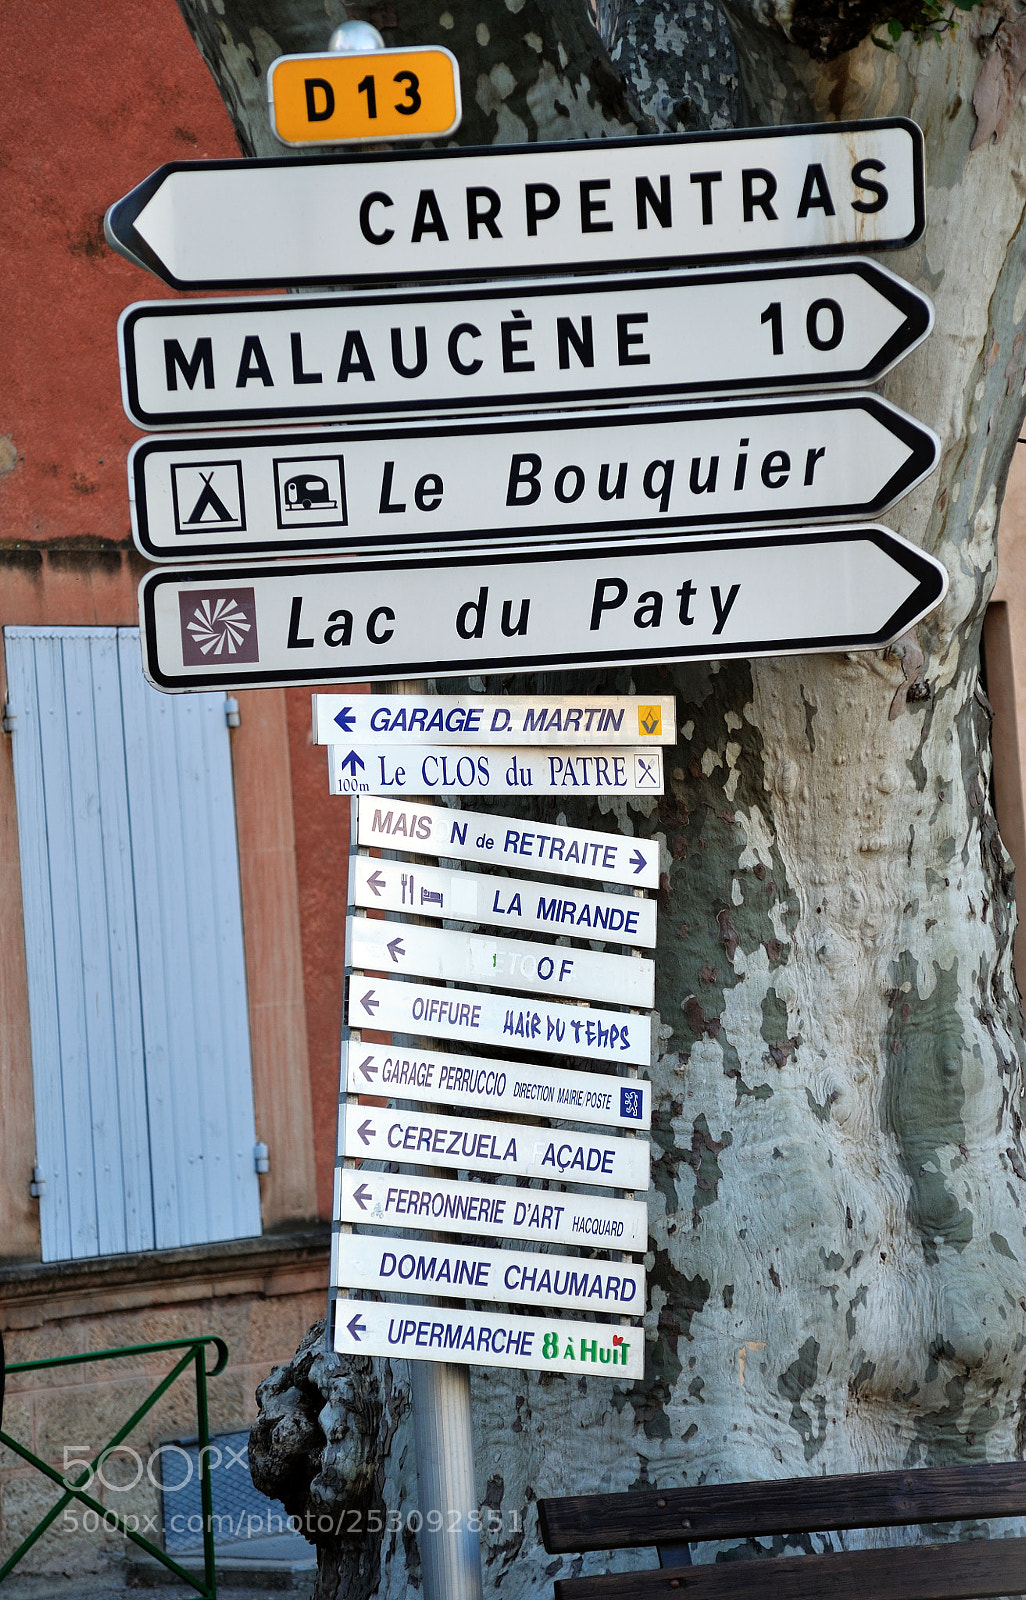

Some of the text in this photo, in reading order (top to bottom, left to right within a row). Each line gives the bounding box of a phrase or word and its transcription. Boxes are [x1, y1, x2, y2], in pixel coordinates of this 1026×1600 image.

[305, 71, 421, 122] D 13
[360, 159, 888, 245] CARPENTRAS
[164, 298, 844, 391] MALAUCÈNE 10
[379, 438, 825, 513] Le Bouquier
[287, 578, 741, 648] Lac du Paty
[371, 708, 625, 732] GARAGE D. MARTIN
[339, 779, 369, 791] 100m
[378, 756, 627, 786] Le CLOS du PATRE
[476, 834, 494, 849] de
[504, 830, 617, 868] RETRAITE
[493, 890, 639, 933] LA MIRANDE
[413, 998, 481, 1027] OIFFURE
[547, 1015, 565, 1042] DU
[383, 1059, 435, 1087] GARAGE
[439, 1066, 506, 1096] PERRUCCIO
[513, 1082, 555, 1102] DIRECTION
[388, 1124, 517, 1161] CEREZUELA
[385, 1188, 623, 1236] FERRONNERIE D'ART HACQUARD
[379, 1253, 636, 1301] DOMAINE CHAUMARD
[388, 1319, 535, 1356] UPERMARCHE
[542, 1332, 559, 1359] 8
